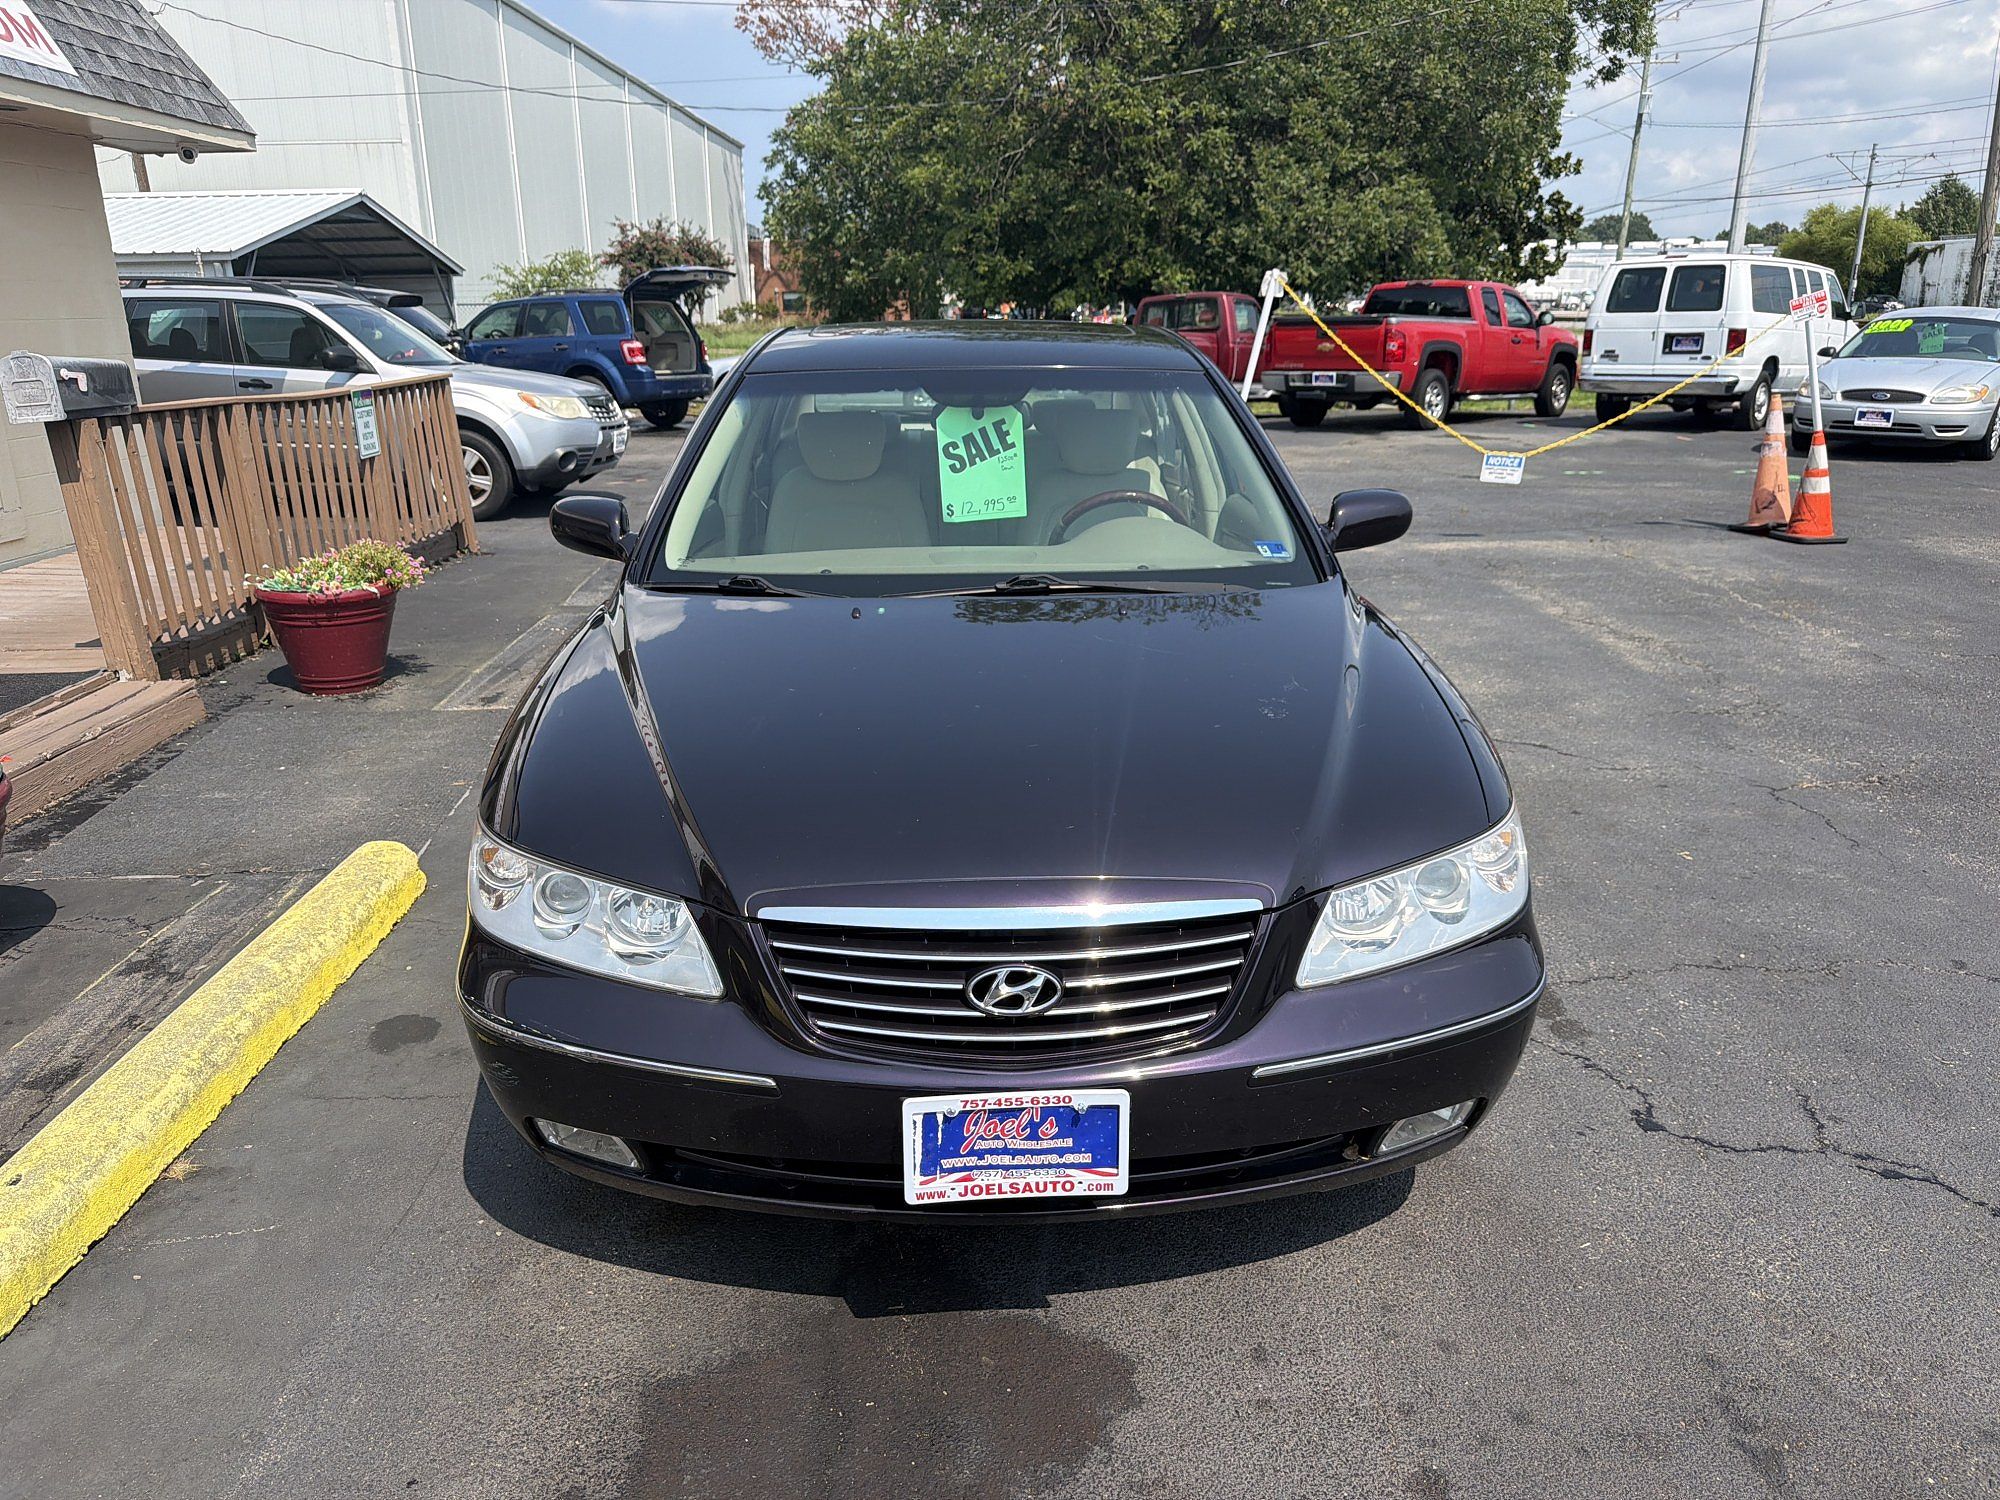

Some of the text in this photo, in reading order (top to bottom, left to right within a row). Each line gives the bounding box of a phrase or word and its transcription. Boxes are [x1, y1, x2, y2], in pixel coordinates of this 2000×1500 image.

[941, 417, 1017, 474] SALE
[1487, 456, 1521, 467] NOTICE
[959, 1095, 1073, 1109] 757-455-6330
[959, 1107, 1059, 1154] Joel's
[971, 1168, 1066, 1179] (757) 455-6330
